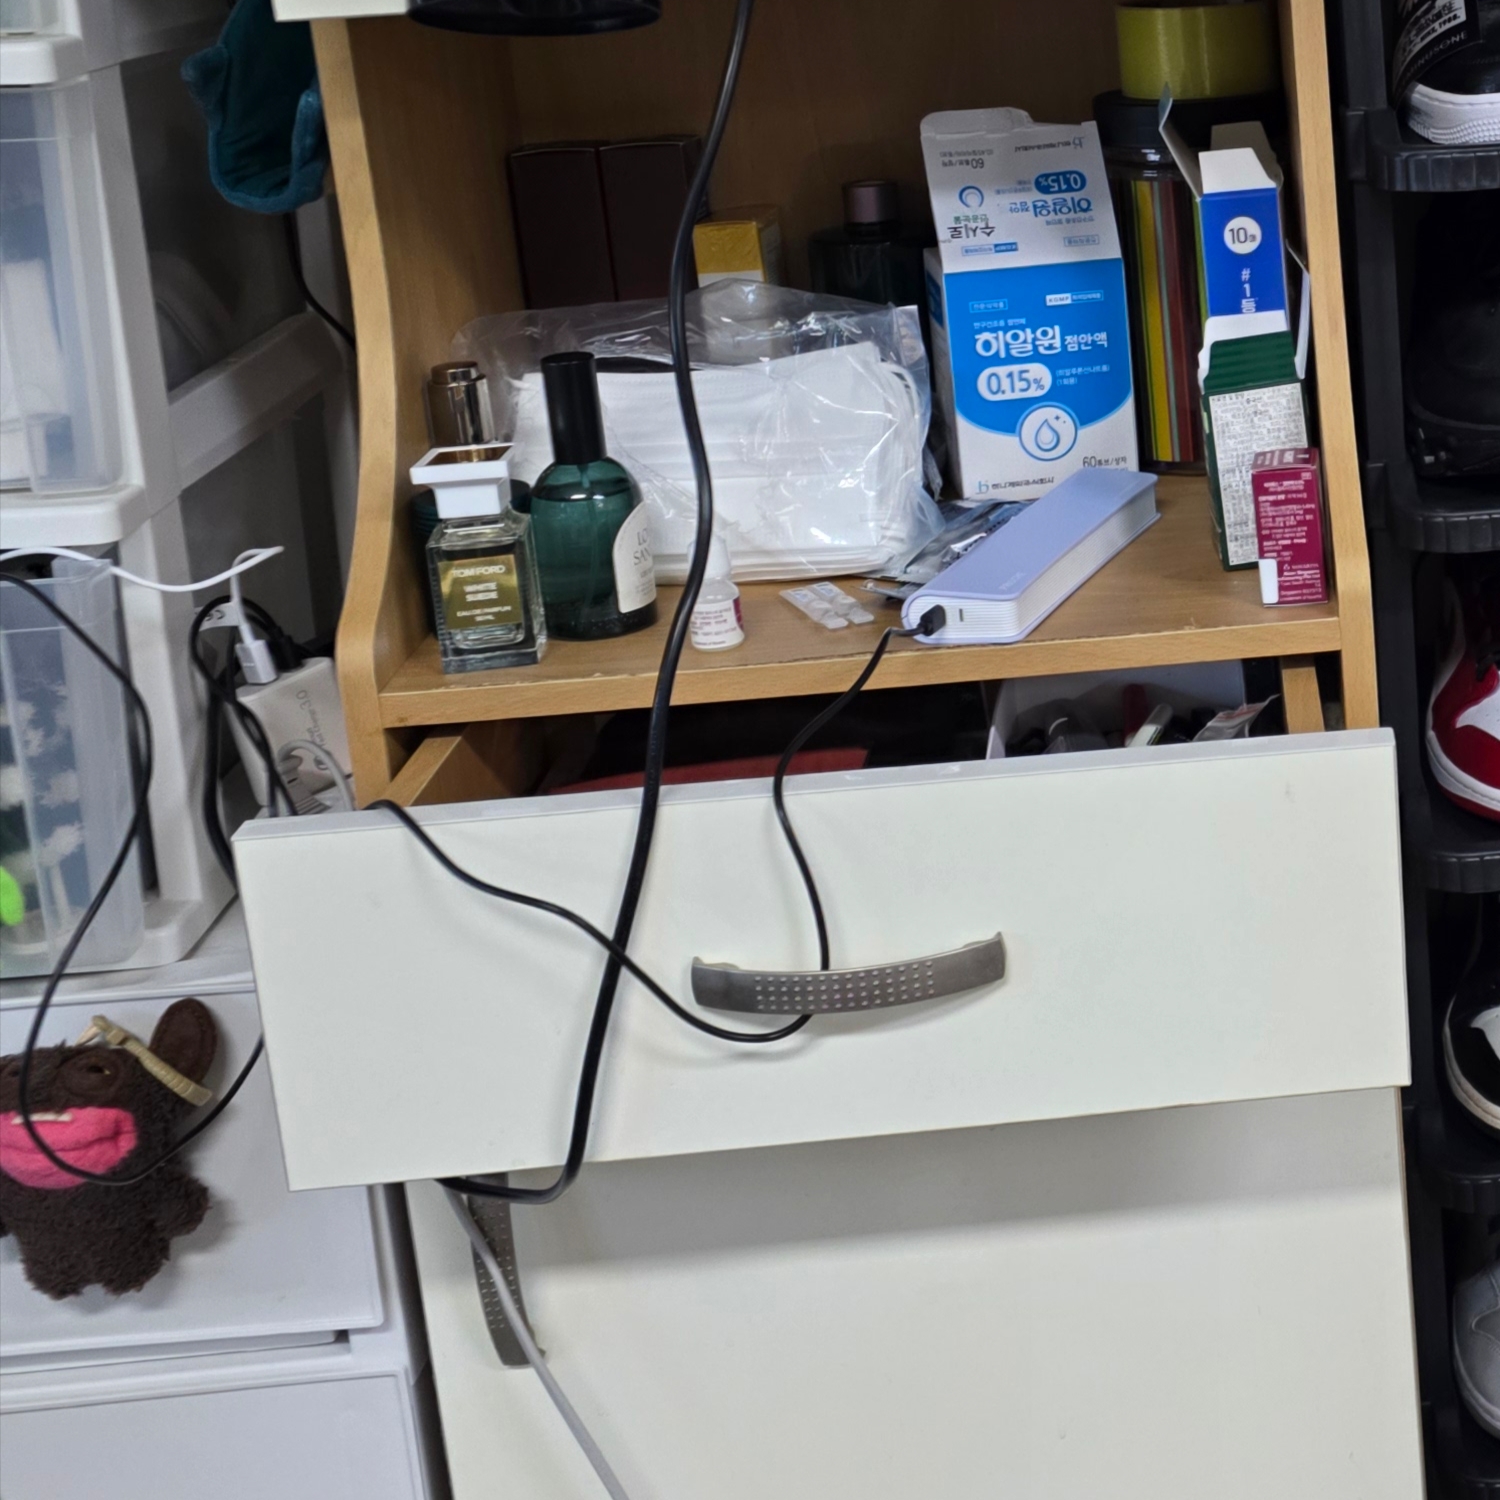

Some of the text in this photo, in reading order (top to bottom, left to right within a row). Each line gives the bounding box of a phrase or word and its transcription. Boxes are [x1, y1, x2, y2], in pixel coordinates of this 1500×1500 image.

[1038, 172, 1083, 192] 0.15%
[1031, 196, 1093, 218] 히알원
[947, 221, 996, 240] 수시로
[974, 324, 1108, 359] 히알원 점안액
[986, 368, 1045, 396] 0.15%
[452, 564, 506, 578] TOM FORD
